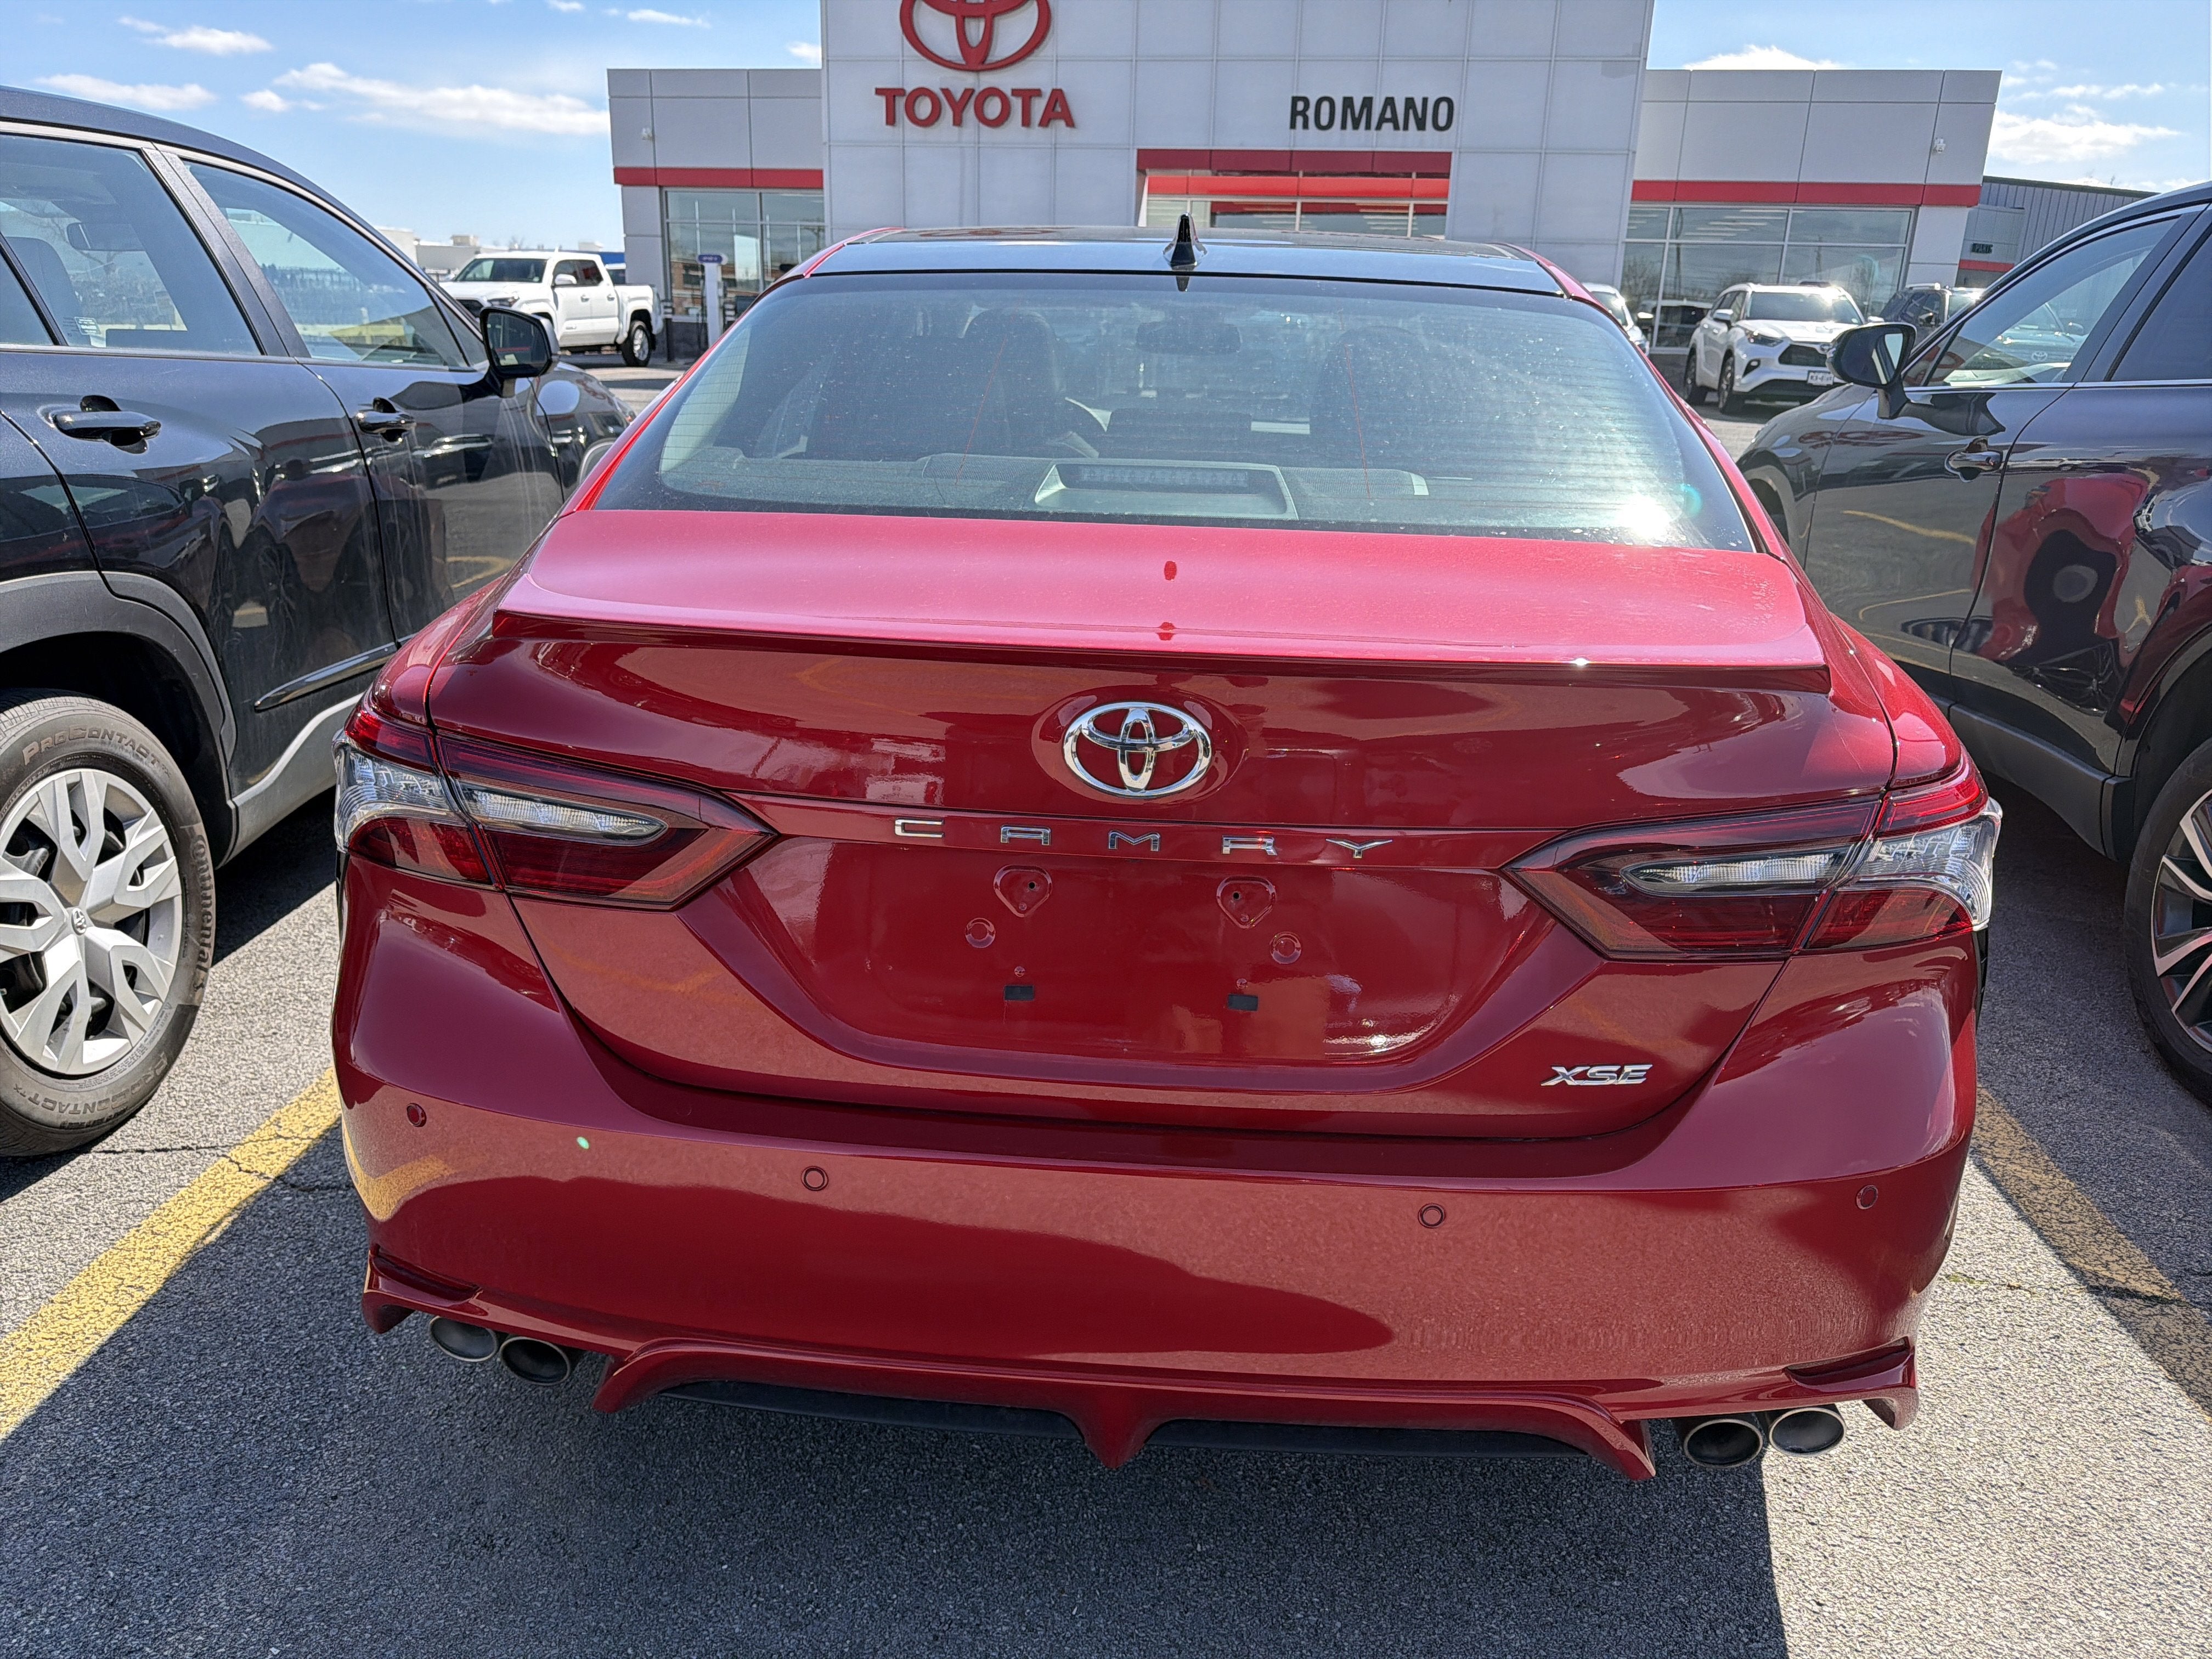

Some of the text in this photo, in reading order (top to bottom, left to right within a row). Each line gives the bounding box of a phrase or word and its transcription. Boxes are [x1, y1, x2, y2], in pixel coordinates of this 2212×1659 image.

[874, 87, 1075, 128] TOYOTA
[1289, 96, 1454, 132] ROMANO
[894, 817, 1393, 859] CAMRY
[1541, 1064, 1653, 1086] XSE
